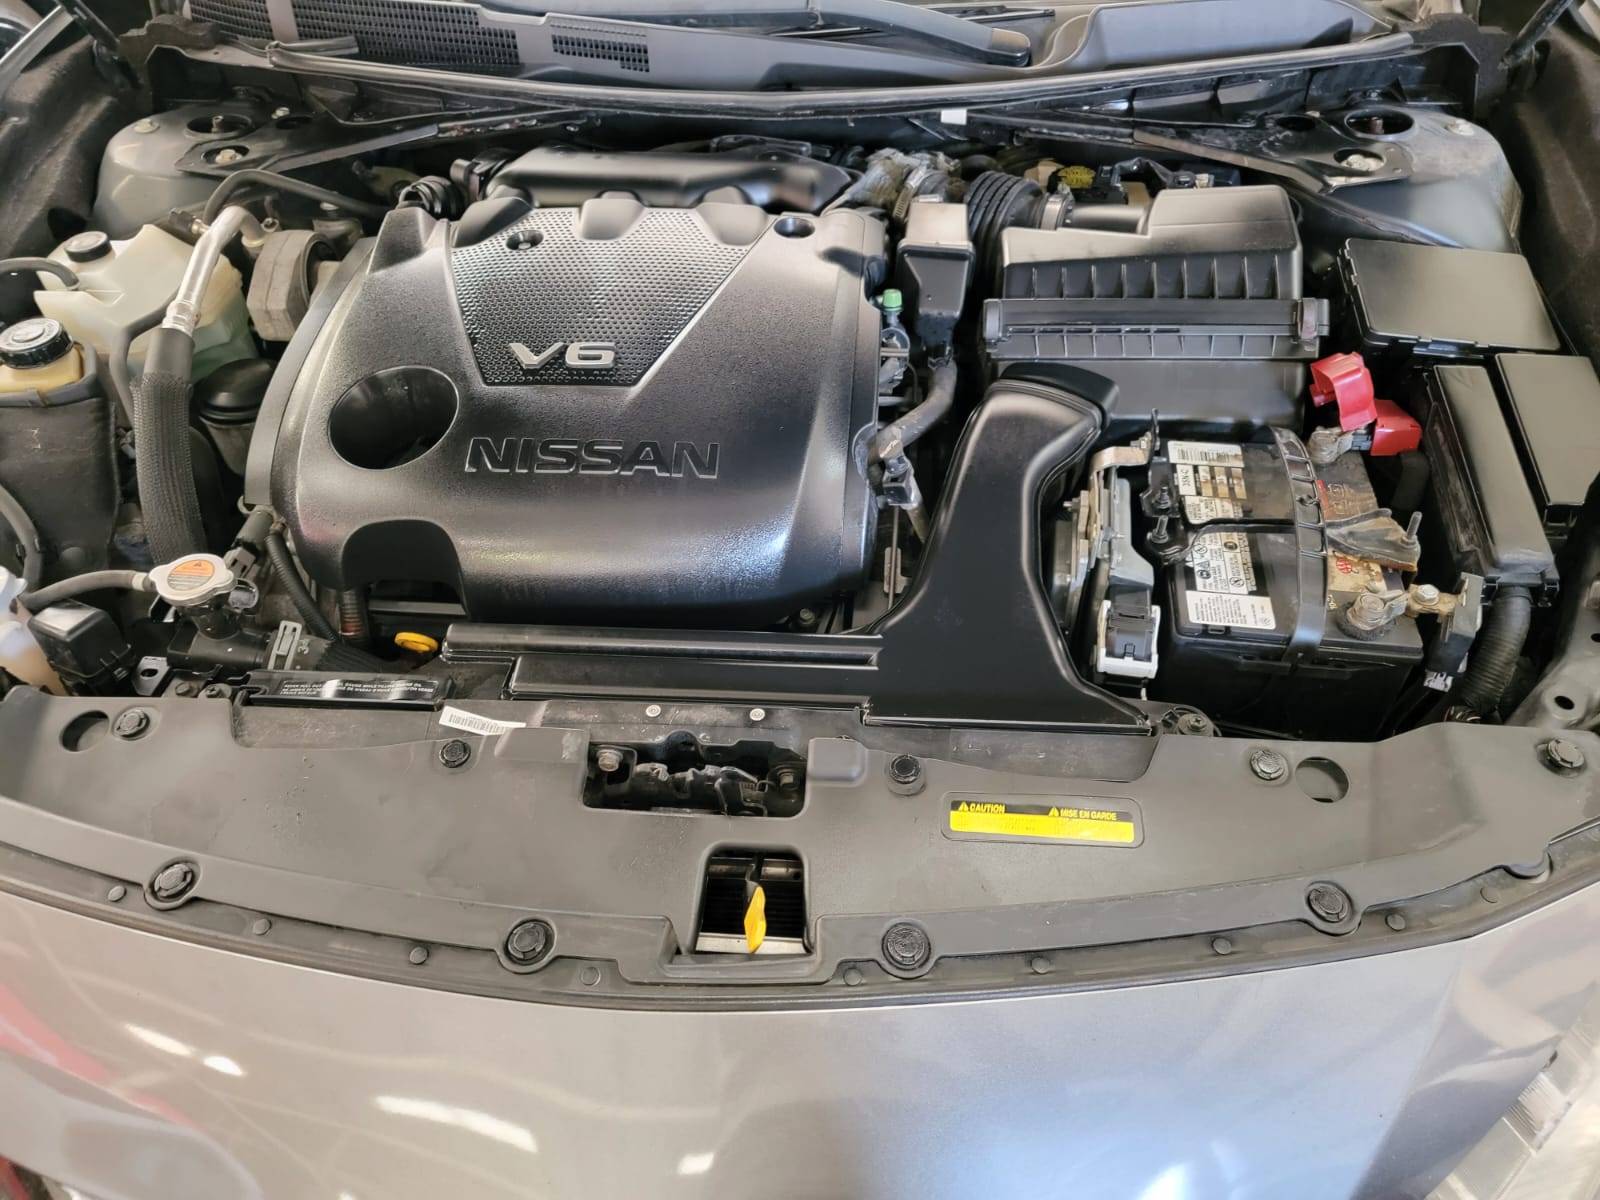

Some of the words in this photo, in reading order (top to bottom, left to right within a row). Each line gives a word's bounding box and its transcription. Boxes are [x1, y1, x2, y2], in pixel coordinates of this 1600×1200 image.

[508, 341, 616, 369] V6
[464, 437, 720, 479] NISSAN
[970, 803, 1005, 814] CAUTION
[1060, 808, 1078, 818] MISE
[1079, 810, 1090, 819] EN
[1090, 811, 1117, 821] GARDE
